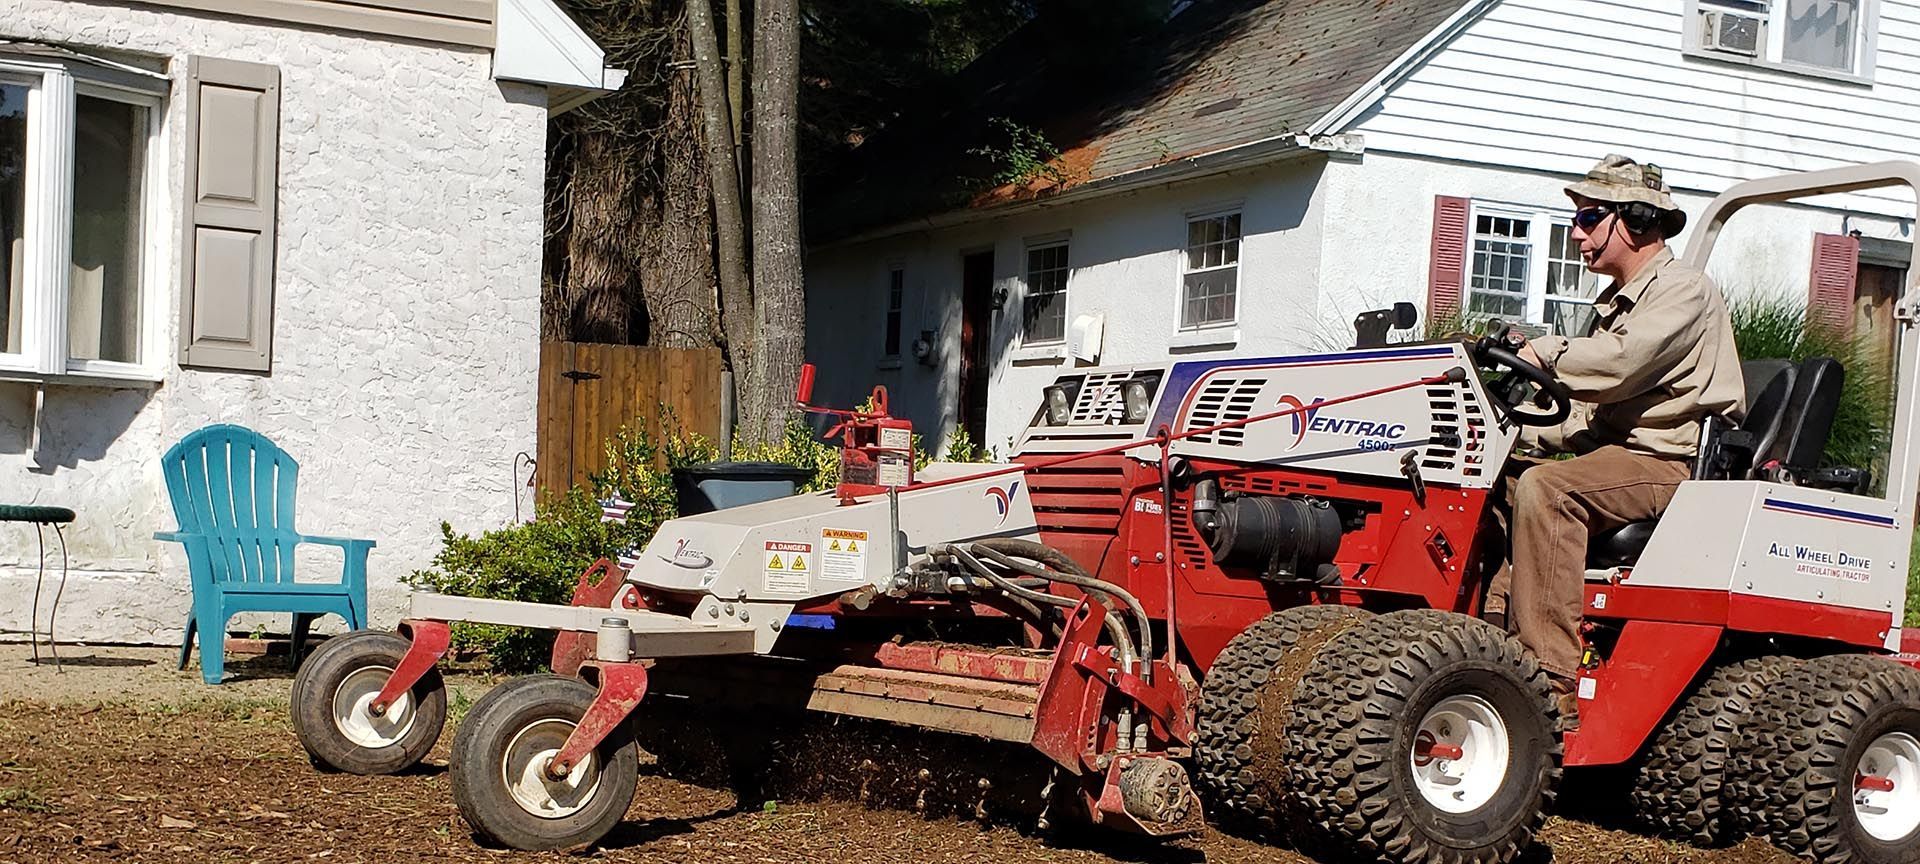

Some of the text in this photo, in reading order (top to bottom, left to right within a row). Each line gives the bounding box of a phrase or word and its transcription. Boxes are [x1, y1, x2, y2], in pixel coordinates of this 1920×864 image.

[1276, 394, 1406, 451] VENTRAC
[833, 530, 864, 539] WARNING
[778, 543, 807, 552] DANGER
[1768, 542, 1871, 569] ALL WHEEL DRIVE
[1796, 564, 1870, 582] ARTICULATING TRACTOR
